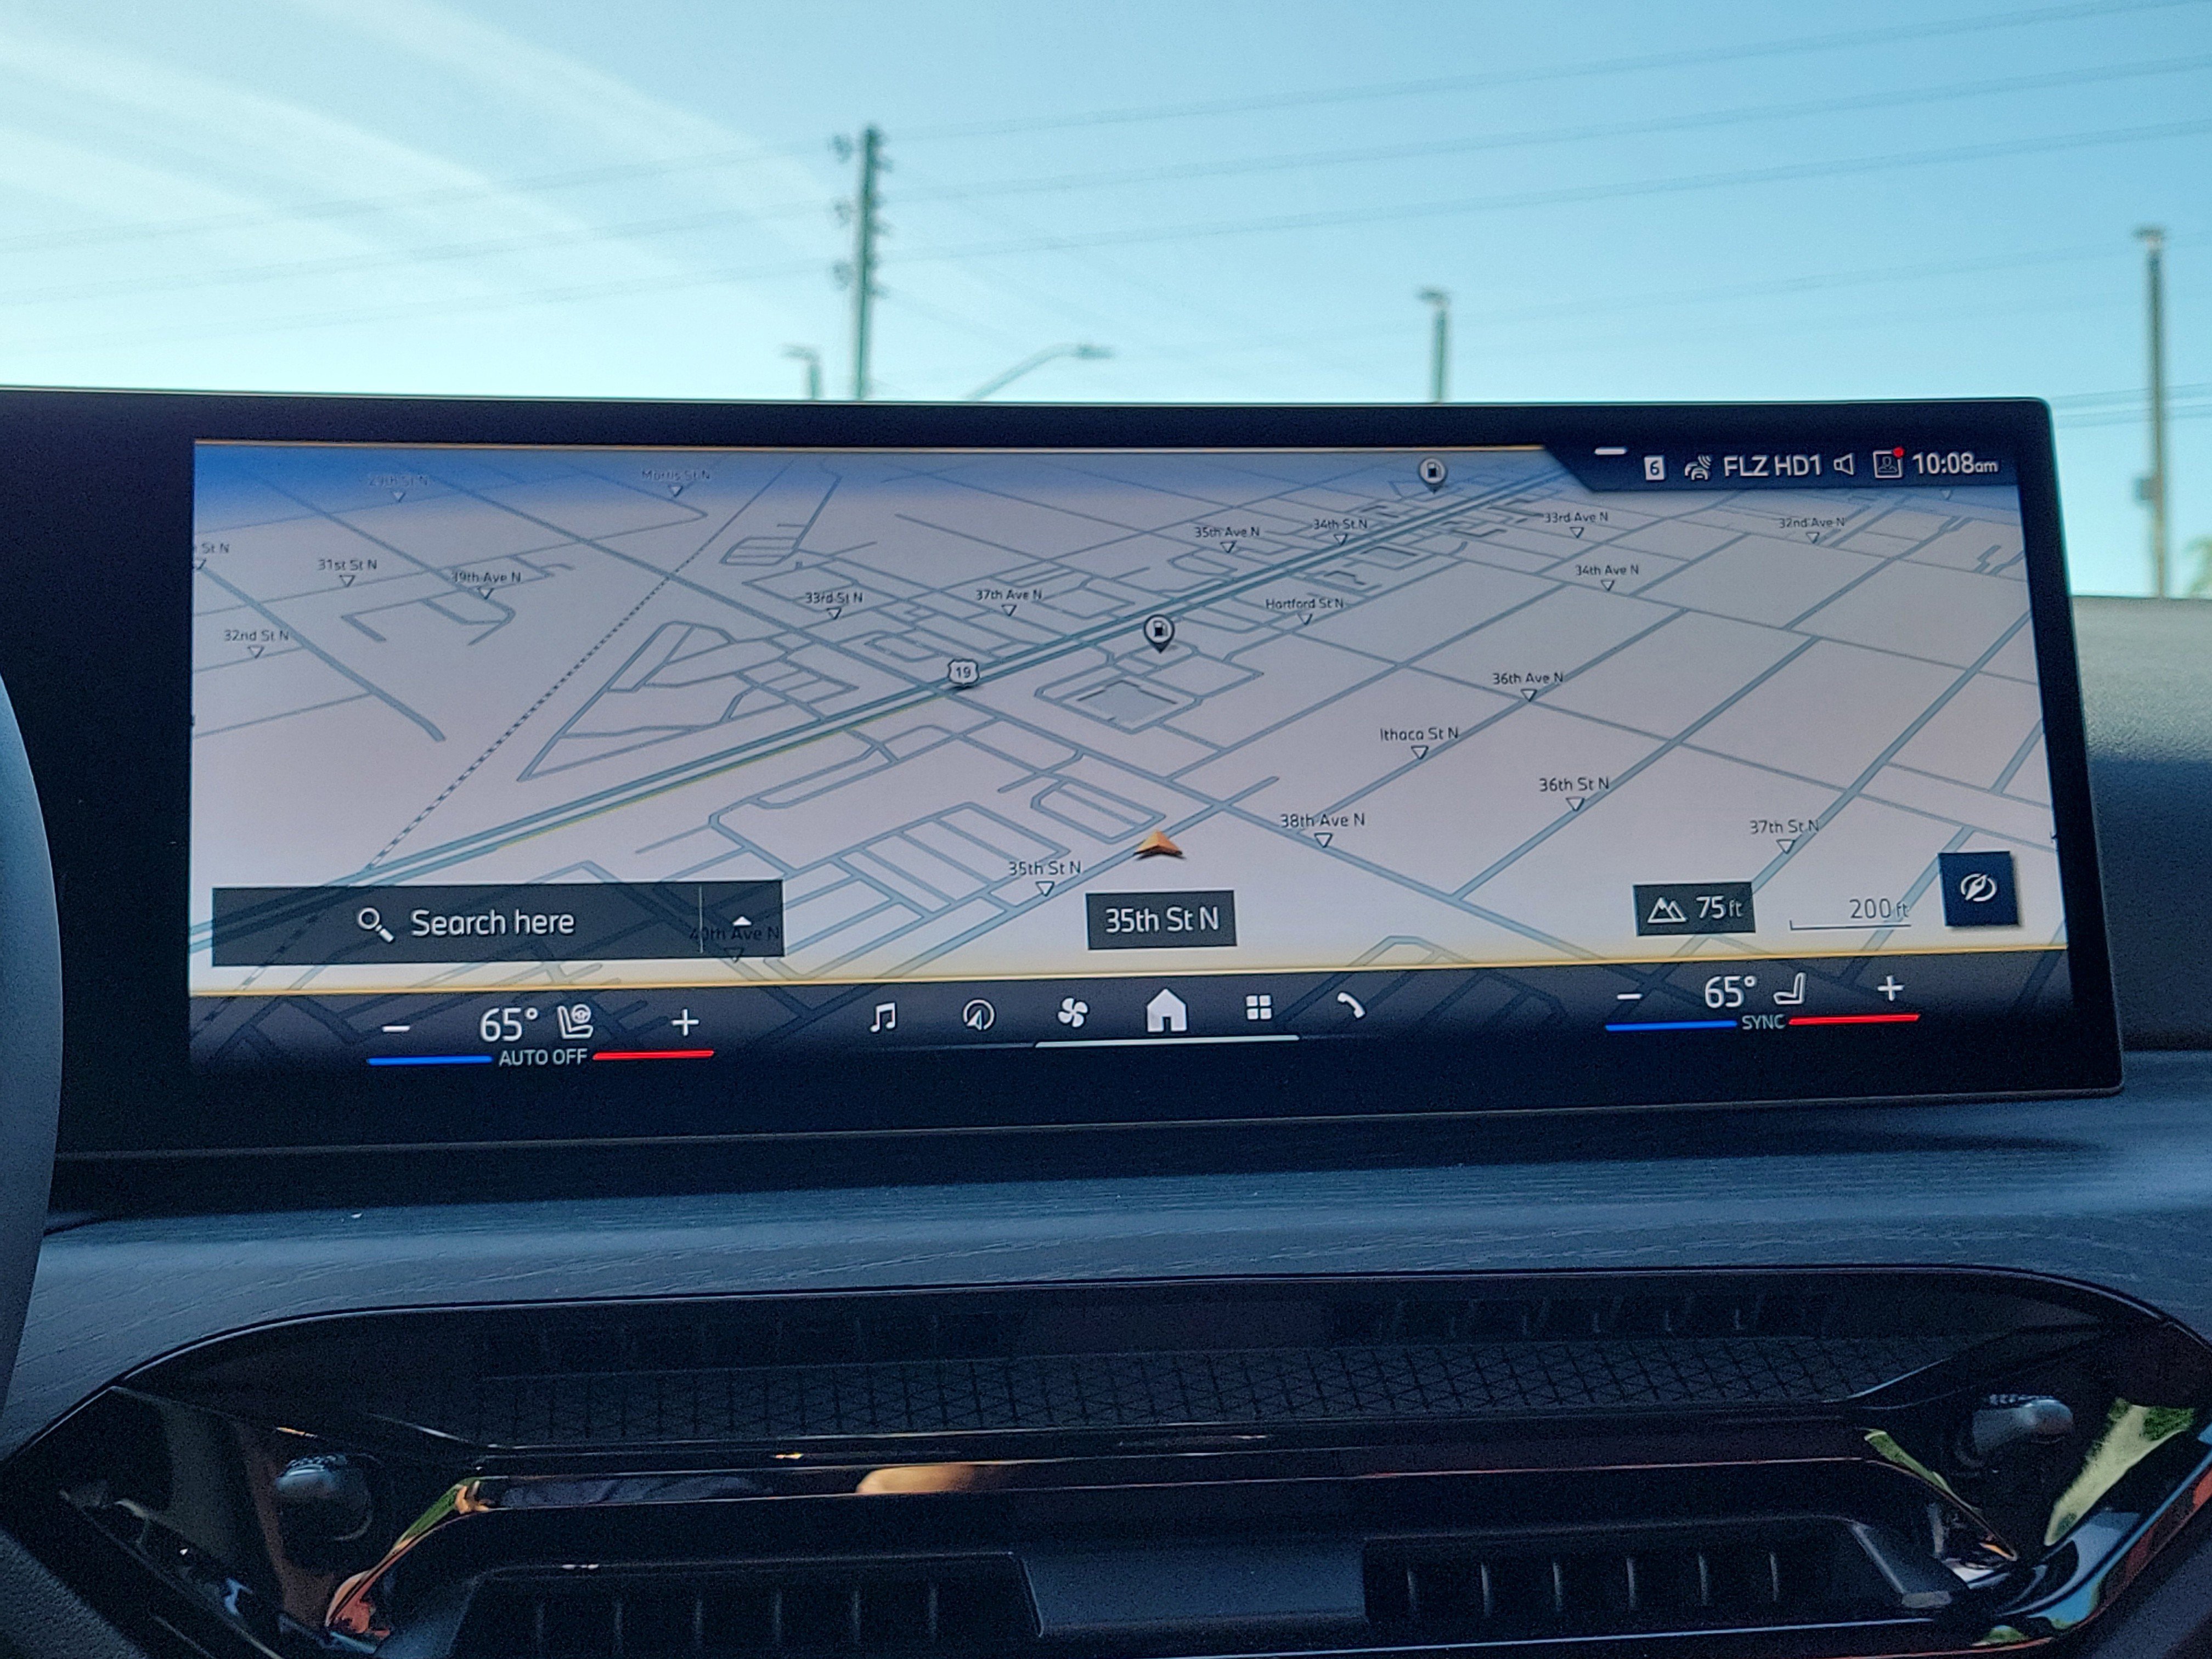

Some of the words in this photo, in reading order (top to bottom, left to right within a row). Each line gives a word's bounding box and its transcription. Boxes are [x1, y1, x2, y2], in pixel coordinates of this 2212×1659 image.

[1724, 454, 1769, 477] FLZ
[1775, 453, 1822, 477] HD1
[1313, 519, 1339, 530] 34th
[1342, 519, 1358, 529] St
[1359, 519, 1368, 529] N
[1544, 512, 1571, 523] 33rd
[1575, 512, 1596, 522] Ave
[1600, 512, 1609, 522] N
[1779, 518, 1808, 529] 32nd
[1811, 518, 1833, 528] Ave
[1837, 517, 1846, 527] N
[1194, 527, 1221, 538] 35th
[1226, 527, 1247, 537] Ave
[1251, 527, 1260, 537] N
[202, 542, 218, 554] St
[220, 542, 230, 554] N
[318, 559, 346, 571] 31st
[350, 559, 364, 571] St
[368, 559, 377, 571] N
[1576, 565, 1601, 576] 34th
[1605, 565, 1627, 575] Ave
[1630, 565, 1639, 574] N
[483, 572, 507, 583] Ave
[511, 571, 521, 583] N
[805, 592, 833, 603] 33rd
[837, 592, 850, 603] St
[853, 592, 862, 603] N
[976, 590, 1003, 601] 37th
[1006, 590, 1029, 600] Ave
[1033, 589, 1042, 600] N
[1266, 599, 1316, 610] Hartford
[1319, 599, 1333, 609] St
[1335, 599, 1344, 608] N
[224, 630, 257, 642] 32nd
[262, 630, 276, 641] St
[279, 630, 289, 641] N
[956, 666, 971, 679] 19
[1492, 673, 1522, 685] 36th
[1525, 673, 1550, 684] Ave
[1554, 672, 1564, 683] N
[1380, 728, 1424, 742] Ithaca
[1428, 727, 1444, 741] St
[1448, 727, 1459, 740] N
[1539, 777, 1573, 792] 36th
[1578, 777, 1594, 792] St
[1599, 777, 1610, 791] N
[1280, 814, 1314, 828] 38th
[1319, 814, 1348, 827] Ave
[1354, 812, 1365, 827] N
[1750, 820, 1784, 834] 37th
[1787, 820, 1805, 834] St
[1809, 819, 1820, 832] N
[1009, 861, 1043, 876] 35th
[1048, 861, 1065, 876] St
[1070, 861, 1081, 874] N
[1696, 895, 1726, 919] 75
[1730, 899, 1743, 918] ft
[1849, 898, 1892, 919] 200
[1897, 901, 1910, 918] ft
[410, 909, 507, 938] Search
[515, 909, 575, 936] here
[1105, 908, 1160, 933] 35th
[1166, 907, 1193, 932] St
[1199, 906, 1219, 931] N
[731, 927, 762, 940] Ave
[768, 926, 780, 940] N
[1705, 975, 1757, 1009] 65°
[479, 1007, 539, 1043] 65°
[1742, 1014, 1787, 1031] SYNC
[499, 1050, 549, 1067] AUTO
[552, 1048, 589, 1065] OFF
